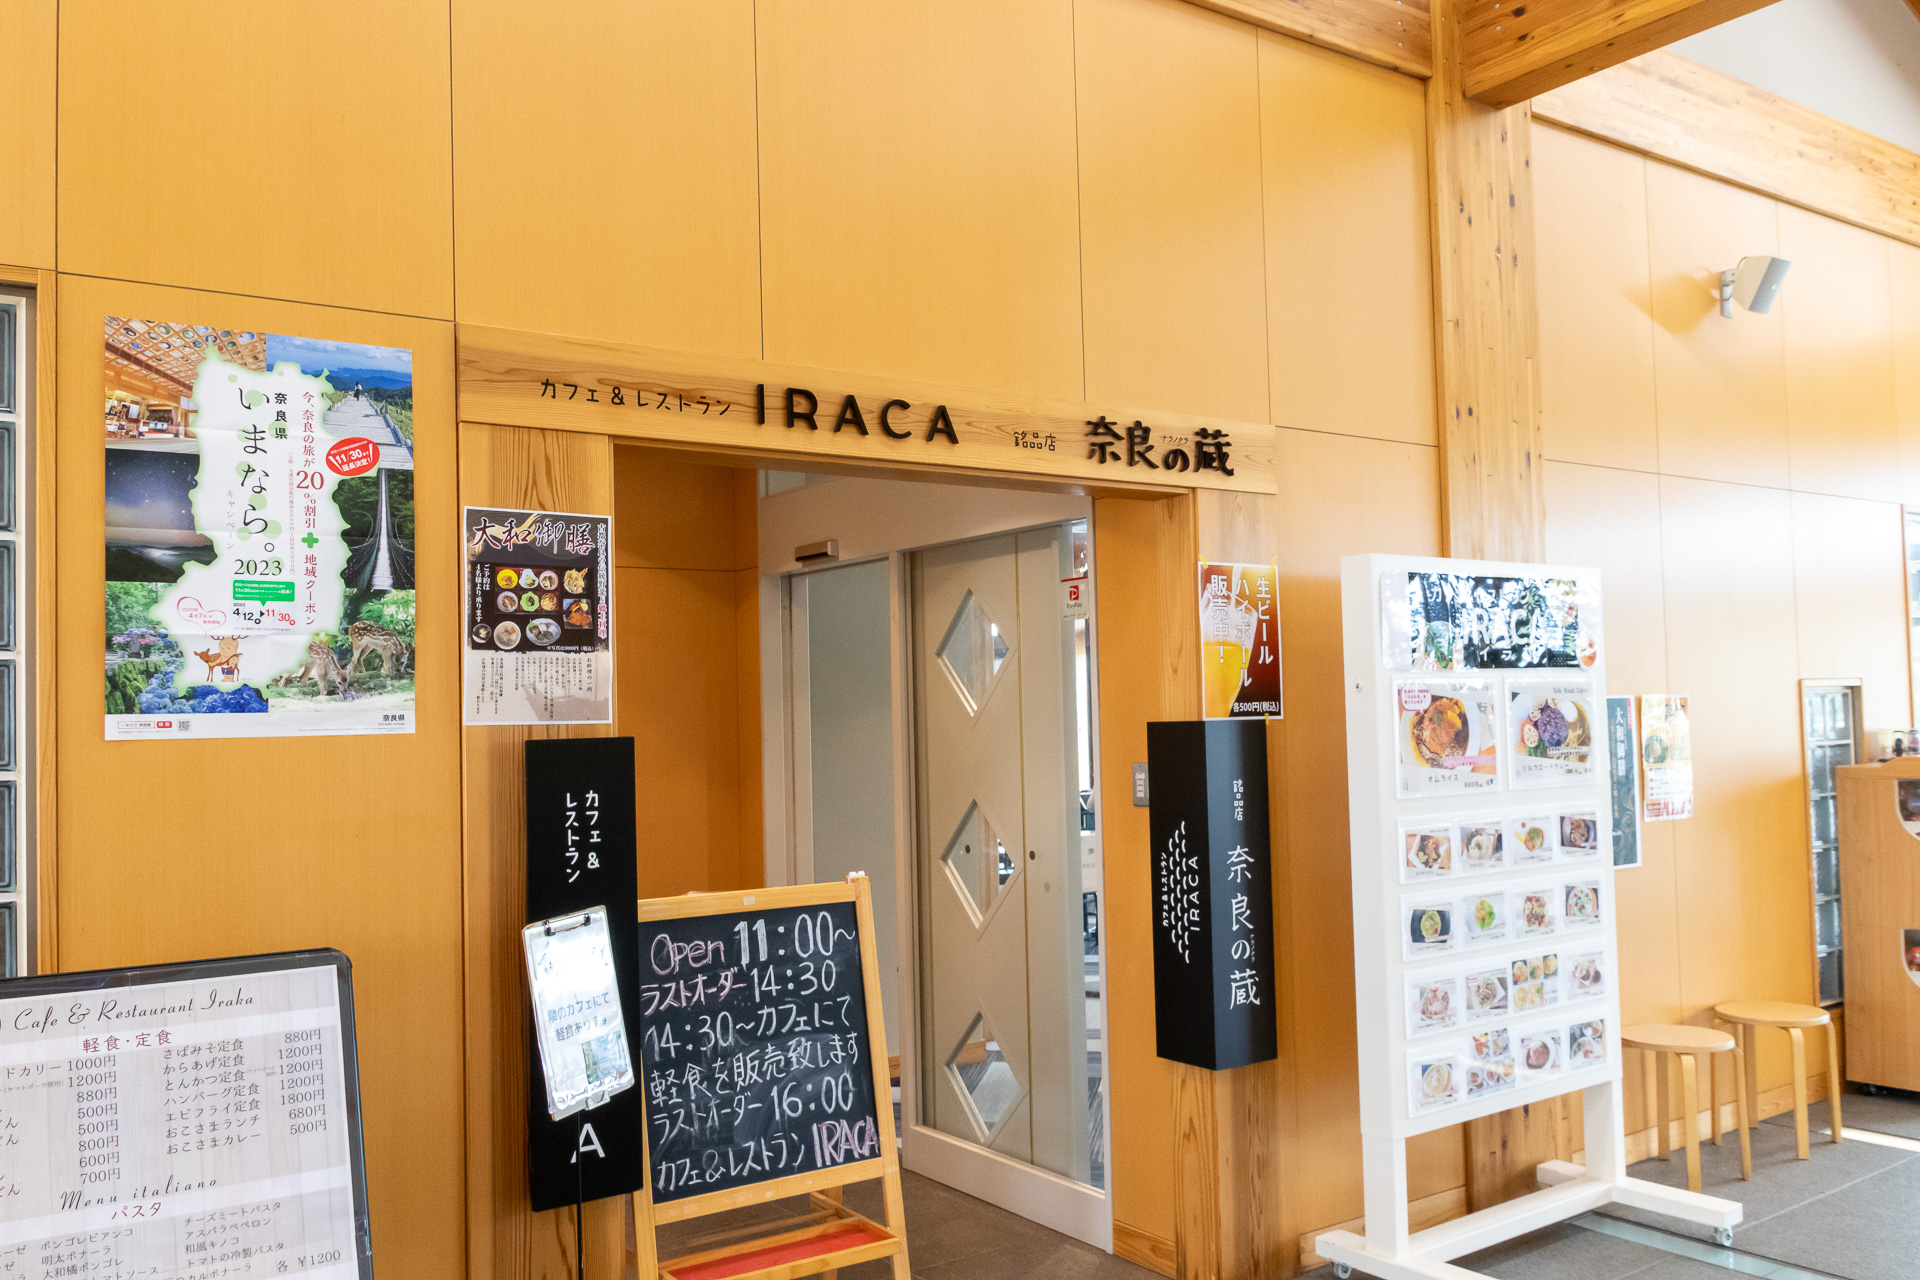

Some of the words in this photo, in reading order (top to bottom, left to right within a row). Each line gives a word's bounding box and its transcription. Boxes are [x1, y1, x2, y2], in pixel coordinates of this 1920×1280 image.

[274, 392, 288, 440] 奈良県
[756, 384, 959, 444] IRACA
[1013, 431, 1056, 451] 銘品店
[1086, 415, 1234, 476] 奈良の蔵
[226, 490, 236, 549] キャンペーン
[470, 517, 596, 555] 大和御膳
[234, 558, 282, 576] 2023
[304, 553, 318, 625] 地域クーポン
[1211, 574, 1230, 664] 販売中!
[1235, 578, 1252, 687] ハイボール
[1256, 576, 1274, 665] 生ビール
[382, 714, 405, 722] 奈良県
[1233, 779, 1244, 821] 銘品店
[565, 792, 580, 883] レストラン
[585, 790, 601, 869] カフェ&
[1188, 856, 1200, 931] IRACA
[1226, 845, 1260, 1010] 奈良の蔵
[650, 934, 726, 975] Open
[641, 966, 747, 1017] ラストオーダー
[750, 959, 836, 1002] 14:30
[14, 1006, 58, 1033] Cafe
[68, 1003, 91, 1024] &
[98, 999, 193, 1022] Restaurant
[200, 988, 253, 1010] Iraka
[82, 1029, 172, 1053] 軽食・定食
[163, 1038, 244, 1060] さばみそ定食
[284, 1029, 321, 1044] 880円
[68, 1055, 116, 1071] 1000円
[162, 1053, 245, 1076] からあげ定食
[278, 1043, 322, 1060] 1200円
[165, 1069, 245, 1091] とんかつ定食
[278, 1058, 323, 1075] 1200円
[650, 1031, 858, 1107] 軽食を販売致します
[68, 1071, 117, 1088] 1200円
[76, 1087, 117, 1103] 880円
[163, 1082, 260, 1107] ハンバーグ定食
[280, 1073, 324, 1090] 1200円
[77, 1103, 118, 1119] 500円
[165, 1098, 260, 1122] エビフライ定食
[280, 1088, 325, 1106] 1800円
[165, 1114, 261, 1139] おこさまランチ
[289, 1103, 326, 1120] 680円
[653, 1091, 763, 1144] ラストオーダー
[771, 1073, 853, 1121] 16:00
[78, 1119, 119, 1136] 500円
[79, 1135, 119, 1152] 800円
[166, 1132, 262, 1155] おこさまカレー
[290, 1119, 327, 1136] 500円
[811, 1115, 881, 1168] IRACA
[79, 1151, 120, 1168] 600円
[80, 1167, 120, 1184] 700円
[60, 1190, 117, 1211] Menu
[133, 1175, 218, 1200] italiano
[111, 1202, 161, 1220] パスタ
[277, 1260, 288, 1273] 各
[297, 1250, 341, 1267] ¥1200
